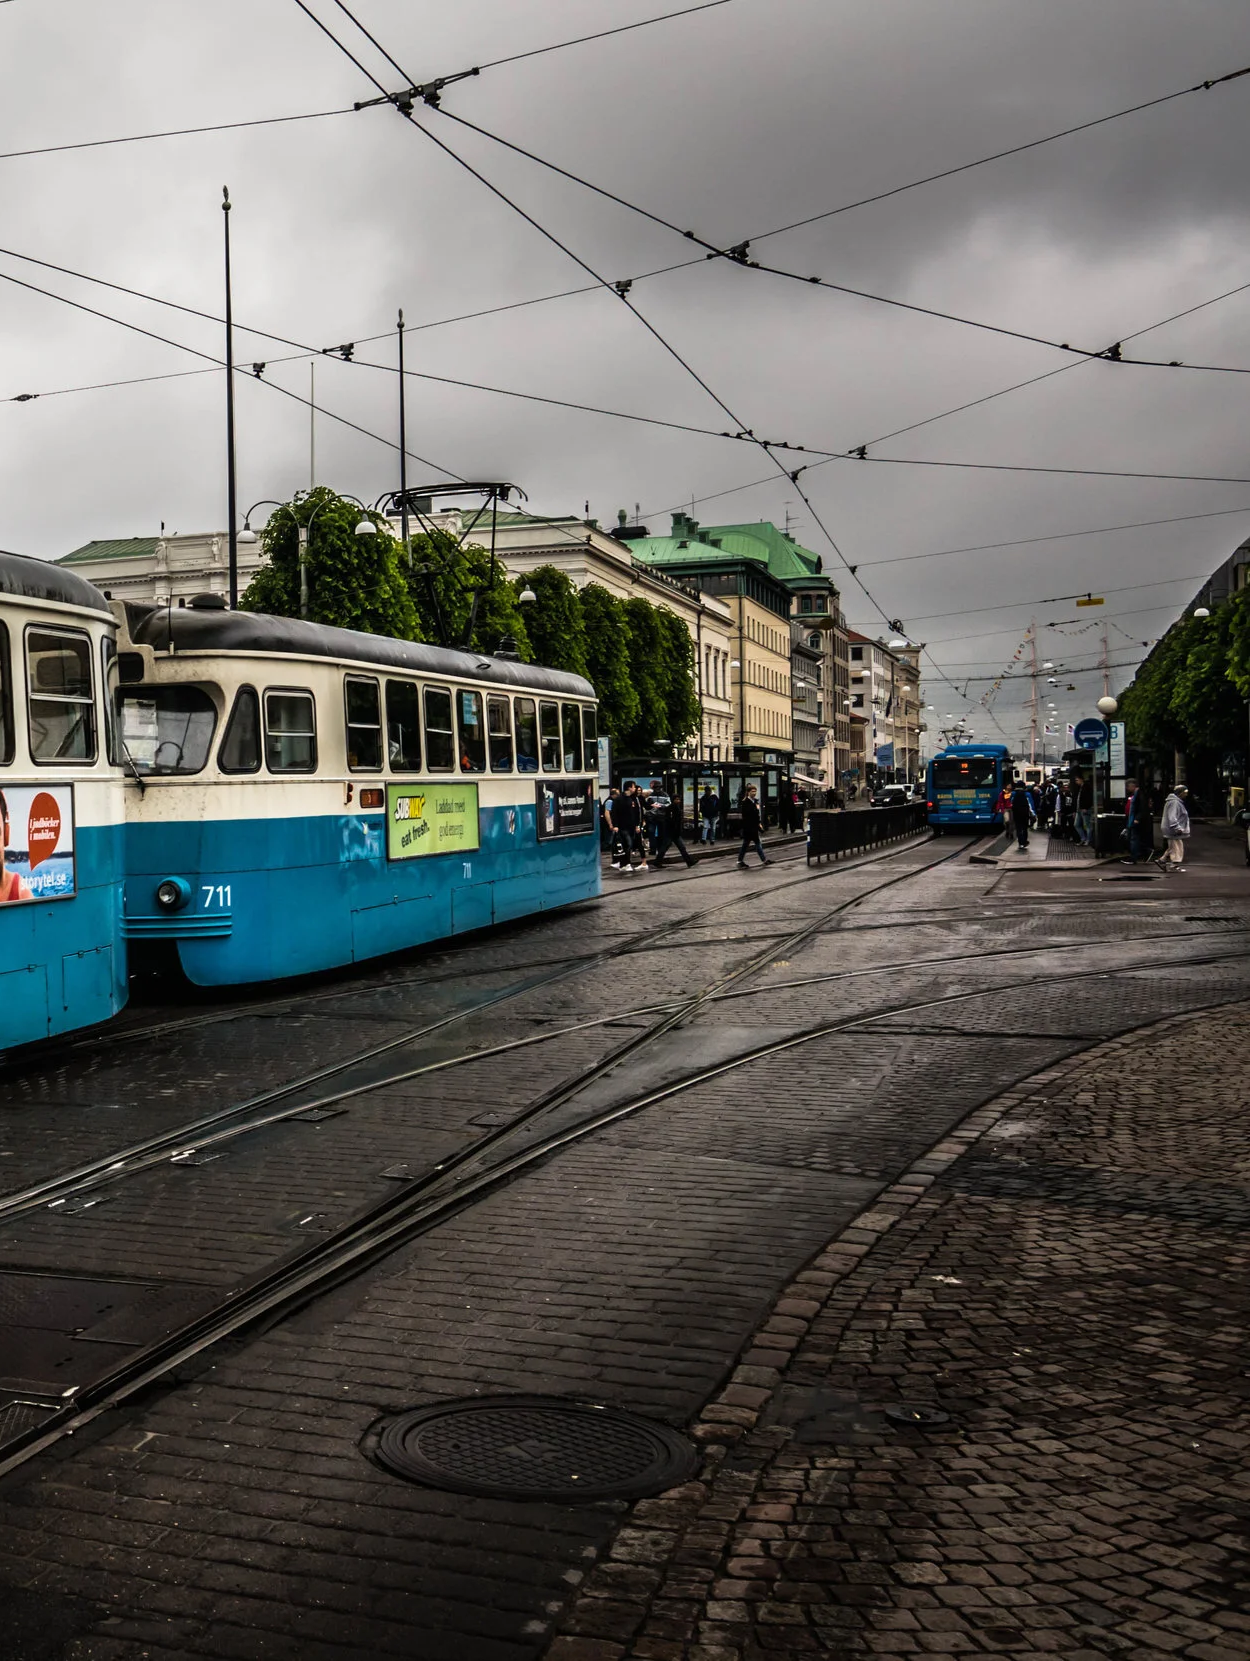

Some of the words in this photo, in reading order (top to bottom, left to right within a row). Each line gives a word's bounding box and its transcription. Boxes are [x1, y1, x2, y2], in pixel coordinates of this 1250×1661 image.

[394, 794, 425, 822] SUBWAY
[401, 829, 412, 848] eat
[412, 819, 430, 840] fresh.
[21, 872, 67, 894] storytel.se
[201, 885, 231, 908] 711
